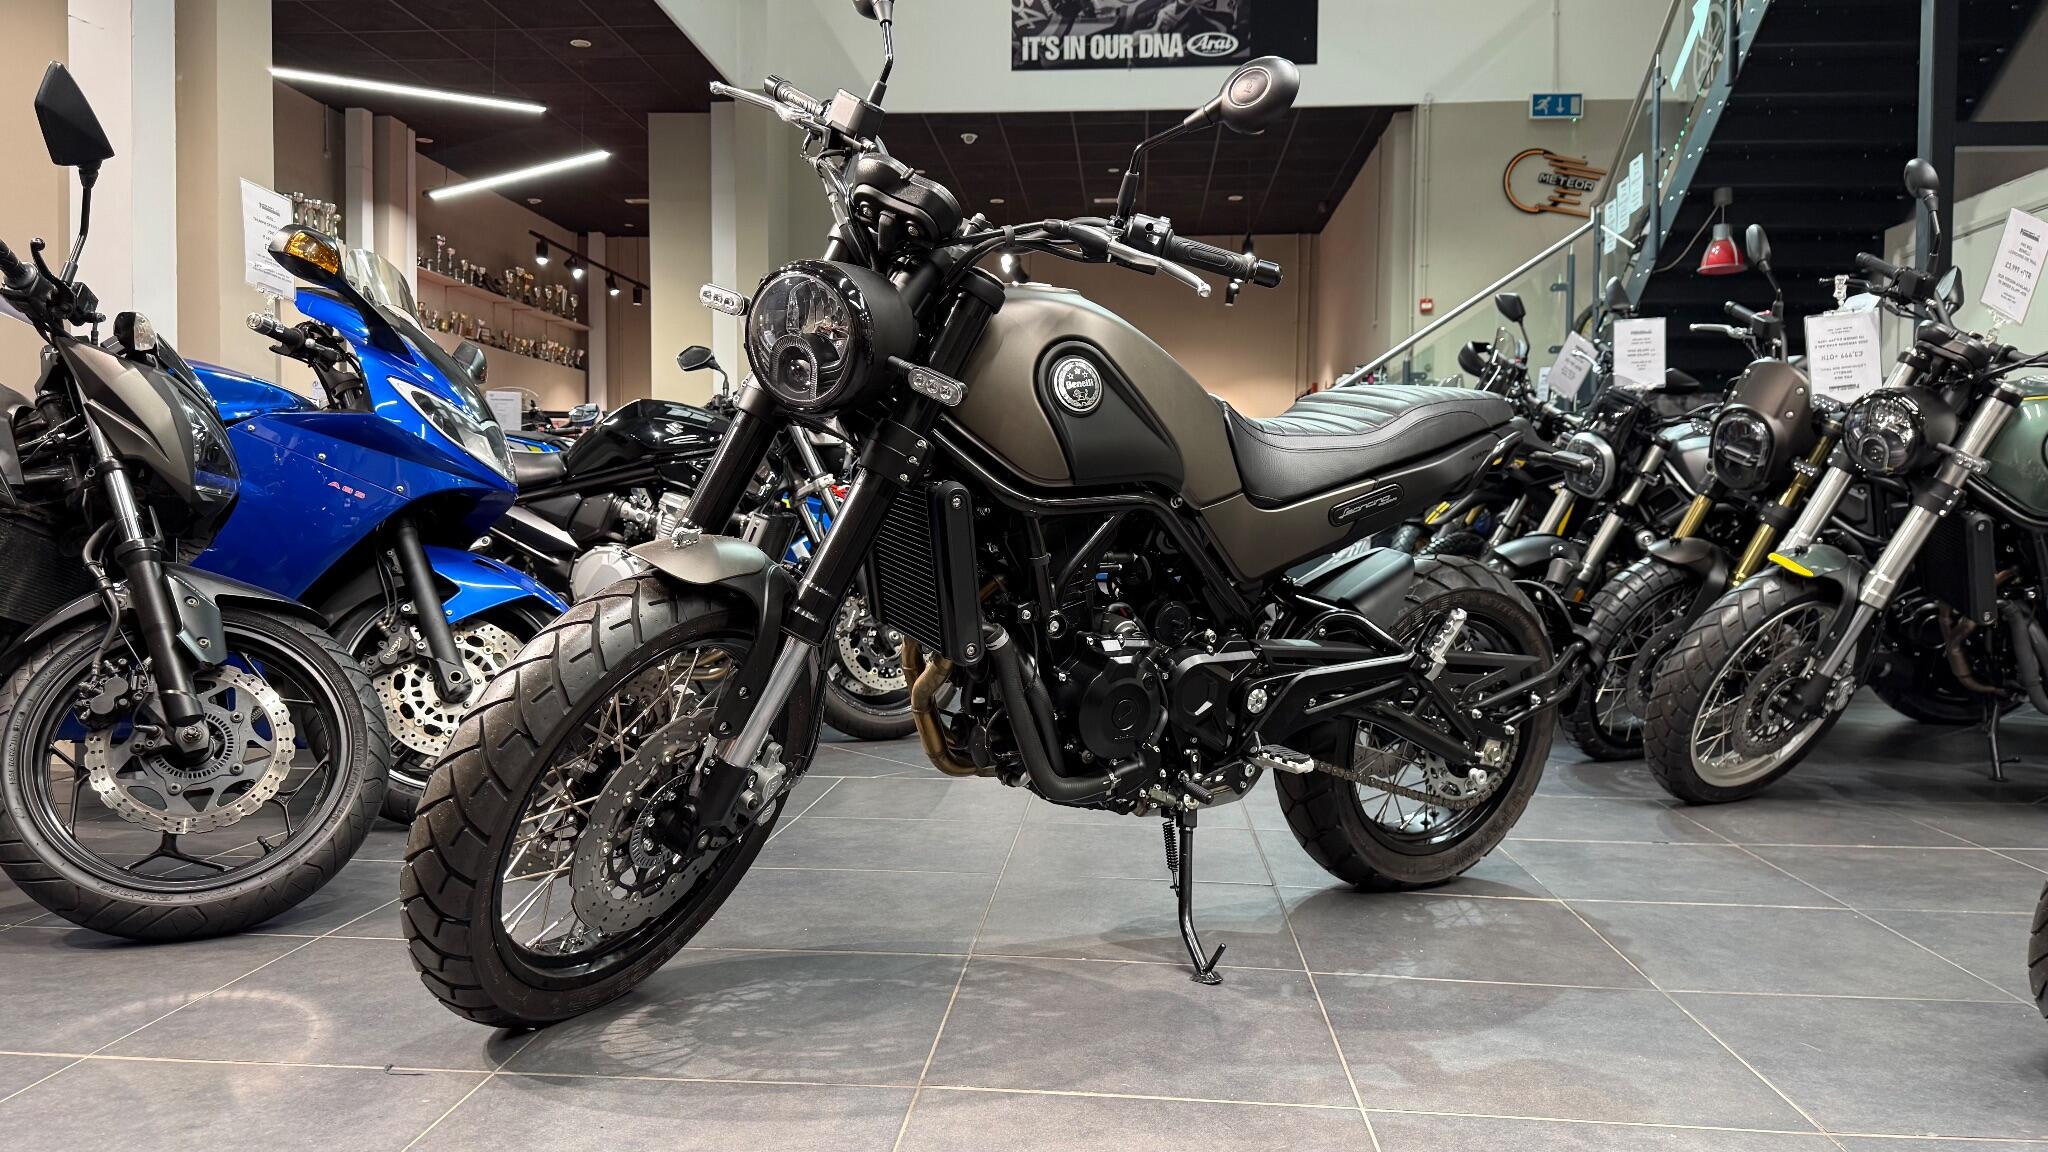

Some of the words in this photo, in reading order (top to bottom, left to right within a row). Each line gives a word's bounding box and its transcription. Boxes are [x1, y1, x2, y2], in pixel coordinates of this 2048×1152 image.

[1022, 36, 1060, 61] IT'S
[1063, 35, 1086, 60] IN
[1090, 34, 1133, 60] OUR
[1139, 33, 1184, 59] DNA
[1538, 172, 1595, 192] METEOR
